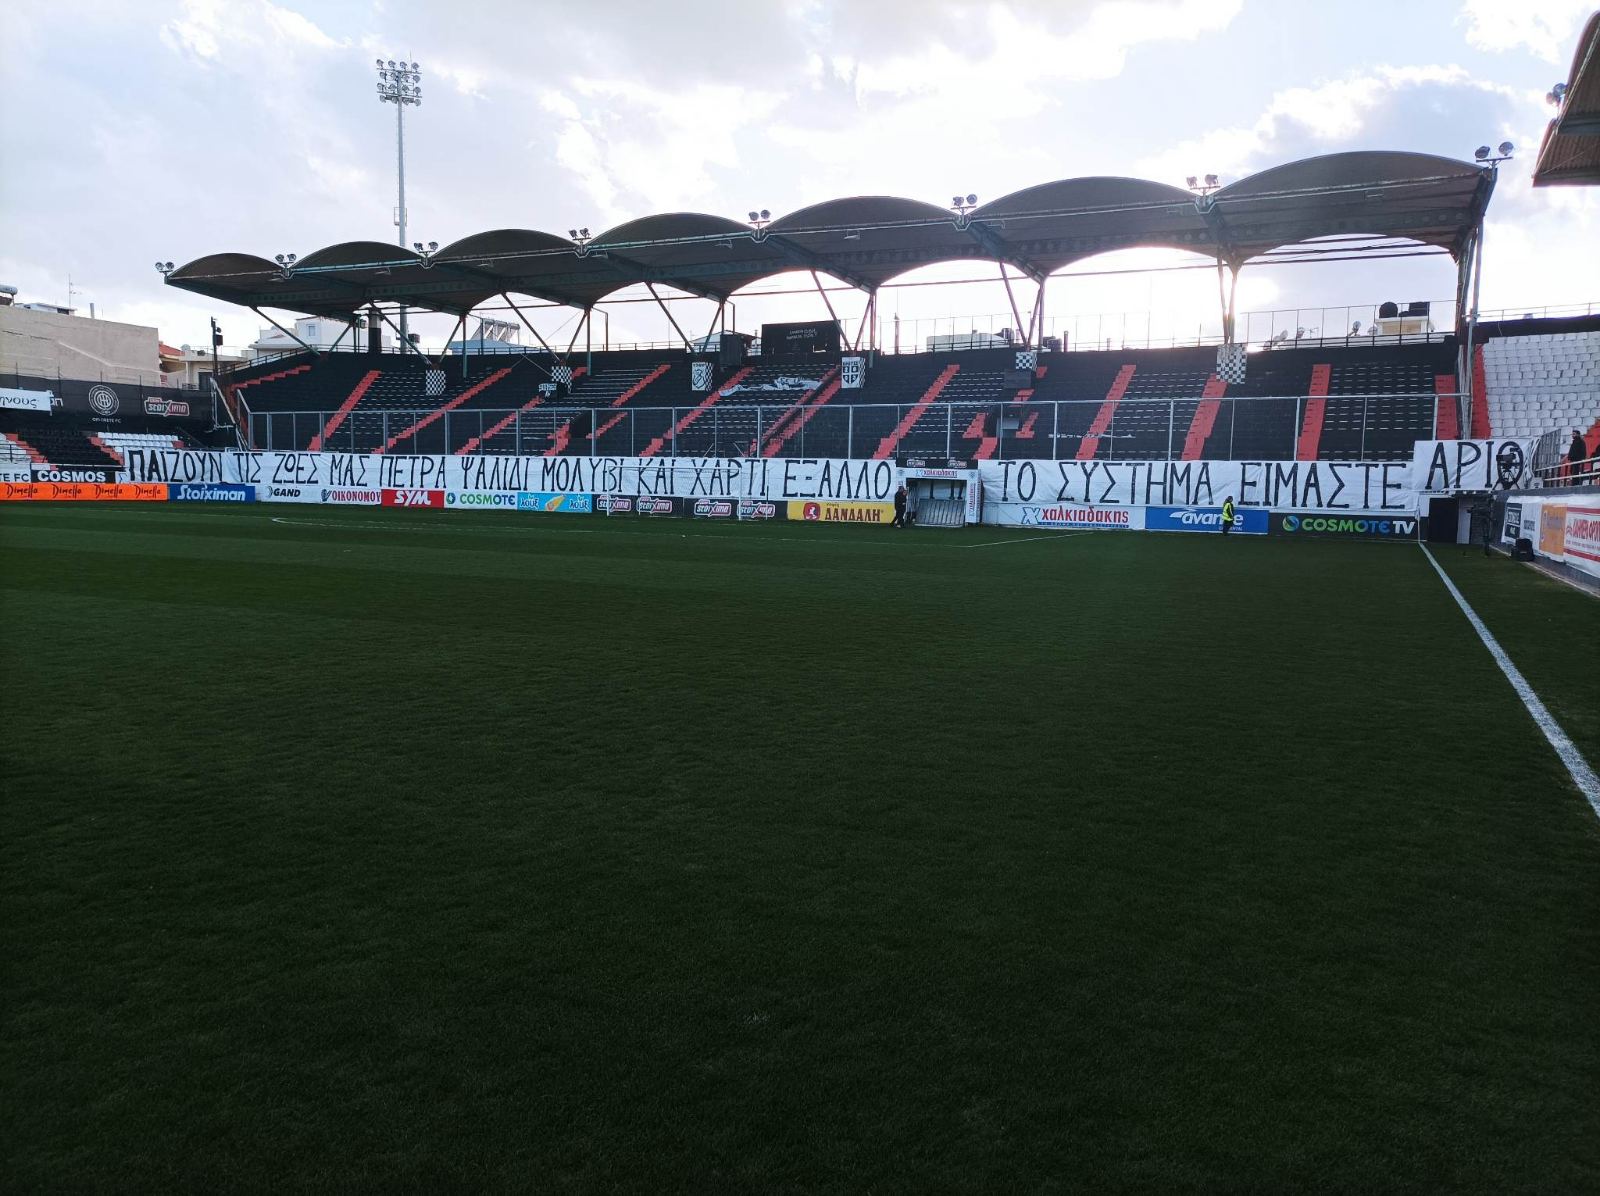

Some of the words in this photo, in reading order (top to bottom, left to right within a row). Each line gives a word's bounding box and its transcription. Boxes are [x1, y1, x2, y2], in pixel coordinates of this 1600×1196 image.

[14, 473, 31, 482] FC
[37, 470, 106, 482] COSMOS
[128, 450, 223, 482] ΠΑΙΖΟΥΝ
[233, 453, 263, 483] ΤΙΣ
[272, 453, 321, 484] ΖΩΕΣ
[329, 454, 370, 487] ΜΑΣ
[379, 456, 447, 488] ΠΕΤΡΑ
[461, 456, 530, 491] ΨΑΛΙΔΙ
[541, 457, 624, 492] ΜΟΛΥΒΙ
[637, 458, 676, 494] ΚΑΙ
[782, 459, 892, 499] ΕΞΑΛΛΟ
[998, 461, 1037, 501] ΤΟ
[1057, 461, 1214, 504] ΣΥΣΤΗΜΑ
[1238, 462, 1407, 509] ΕΙΜΑΣΤΕ
[177, 485, 246, 501] Stoiximan
[273, 488, 301, 498] GAND
[394, 491, 431, 507] SYM
[460, 493, 516, 506] COSMOTE
[1182, 512, 1243, 526] avane
[1301, 518, 1391, 533] COSMOTE
[1393, 520, 1415, 534] TV
